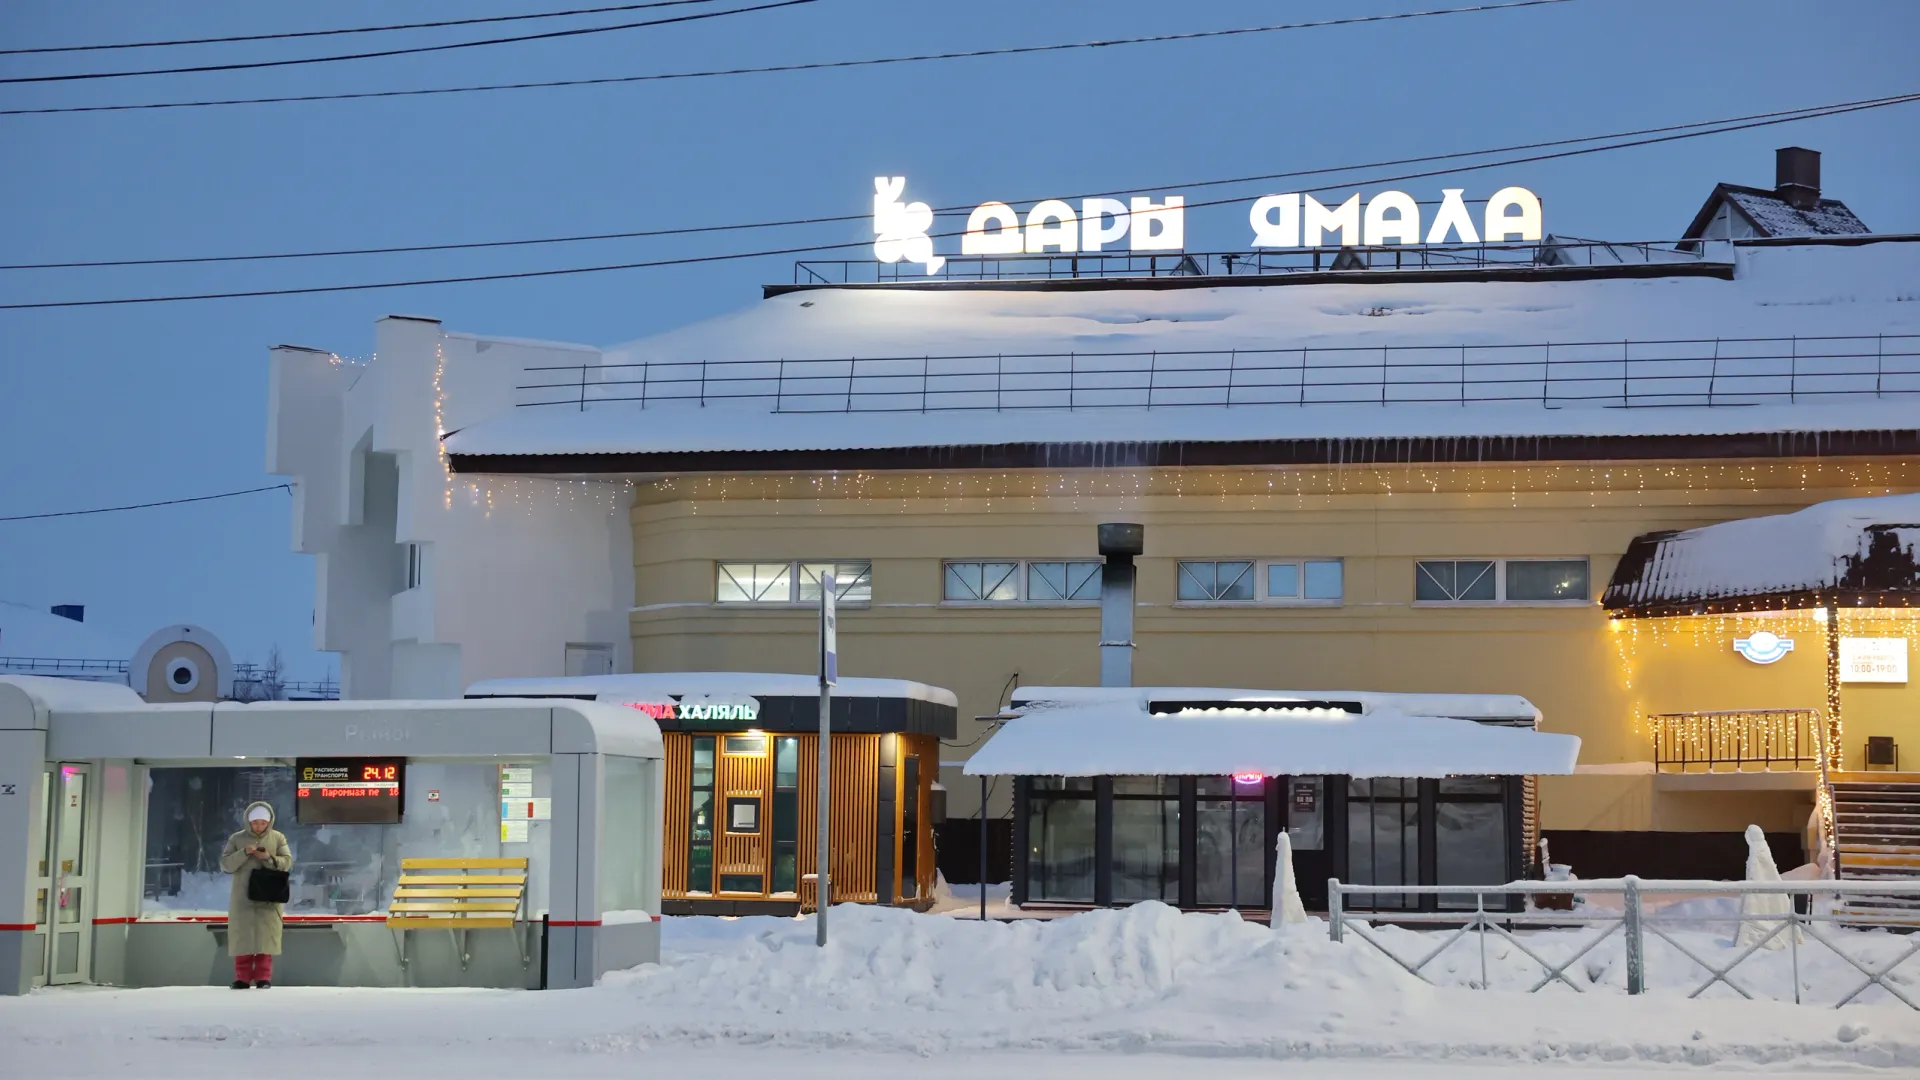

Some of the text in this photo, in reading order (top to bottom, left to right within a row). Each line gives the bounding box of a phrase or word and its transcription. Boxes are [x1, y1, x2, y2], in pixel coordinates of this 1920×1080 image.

[961, 187, 1541, 255] ДАРЫ ЯМАЛА
[678, 704, 757, 720] ХАЛЯЛЬ
[364, 766, 395, 779] 24.12
